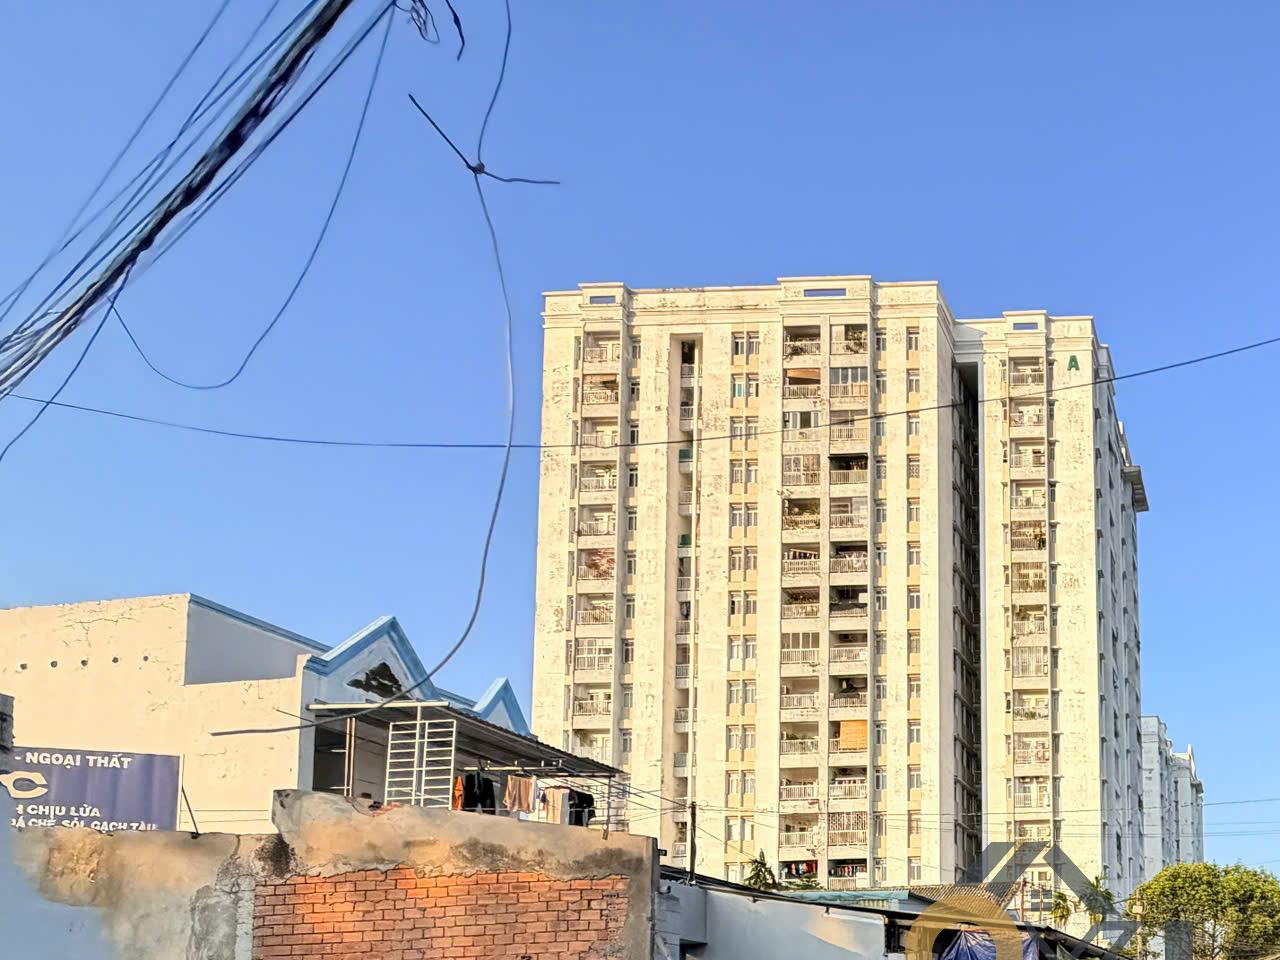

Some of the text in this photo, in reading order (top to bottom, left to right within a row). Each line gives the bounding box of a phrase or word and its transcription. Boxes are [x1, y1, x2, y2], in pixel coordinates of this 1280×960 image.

[1067, 354, 1080, 371] A
[25, 752, 82, 769] NGOẠI
[85, 753, 133, 769] THẤT
[26, 804, 66, 819] CHỊU
[70, 804, 101, 818] LỬA
